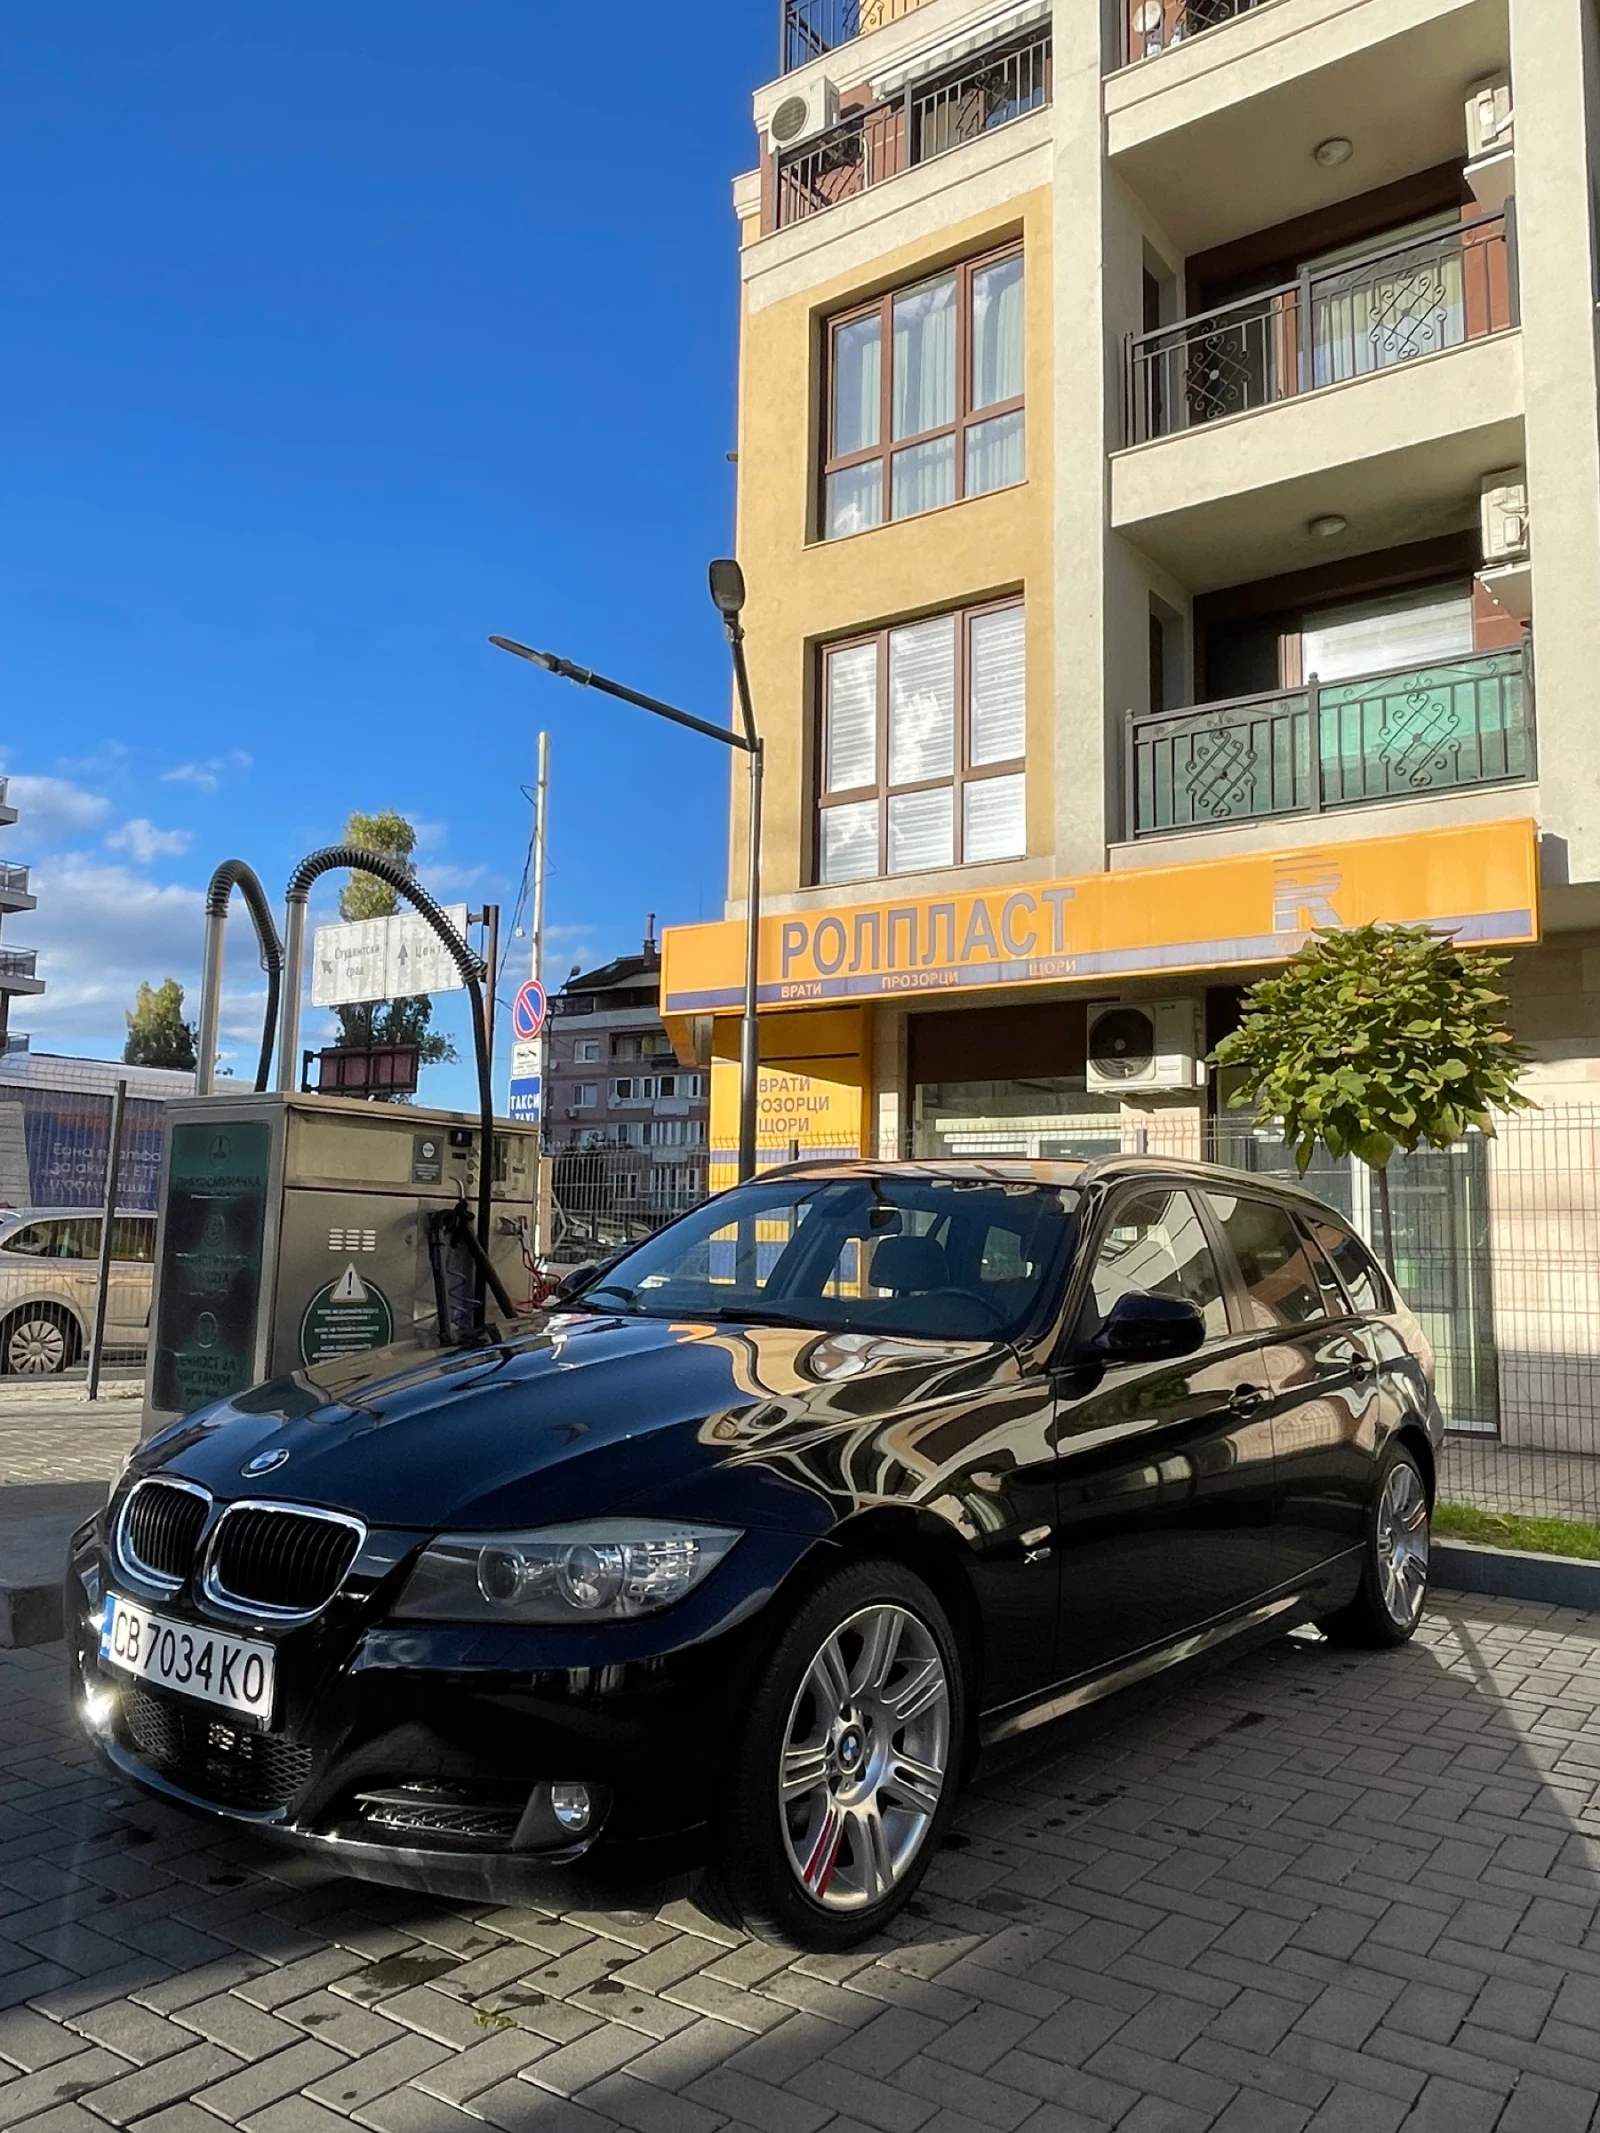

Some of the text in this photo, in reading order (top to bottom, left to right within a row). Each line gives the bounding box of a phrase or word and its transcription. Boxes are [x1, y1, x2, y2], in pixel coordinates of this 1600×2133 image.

[782, 888, 1075, 978] РОЛПЛАСТ
[781, 960, 1077, 998] ВРАТИ ПРОЗОРЦИ ЩОРИ
[759, 1076, 810, 1093] ВРАТИ
[510, 1093, 540, 1110] ТАКСИ
[759, 1117, 809, 1134] ЩОРИ
